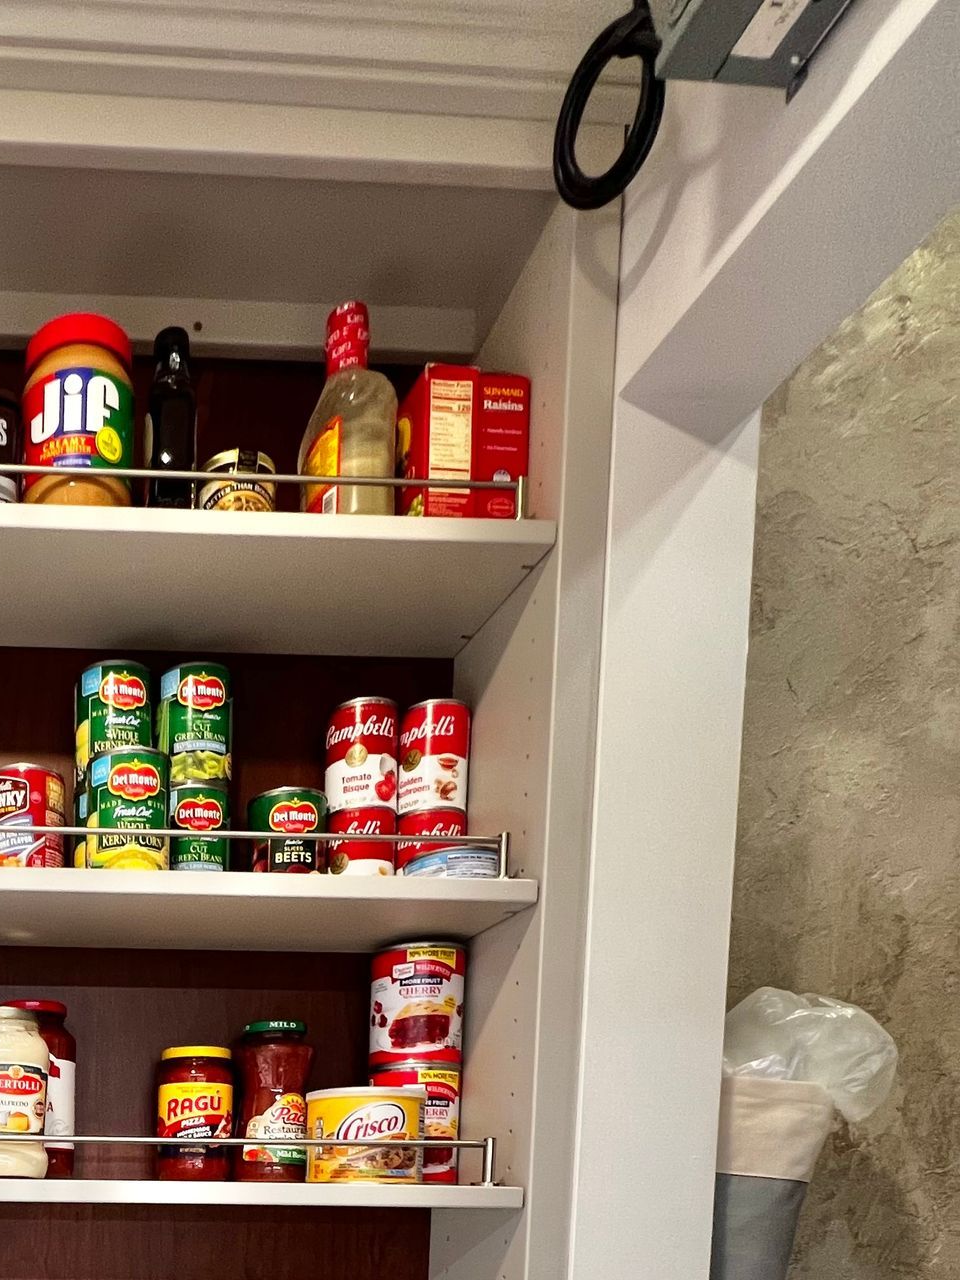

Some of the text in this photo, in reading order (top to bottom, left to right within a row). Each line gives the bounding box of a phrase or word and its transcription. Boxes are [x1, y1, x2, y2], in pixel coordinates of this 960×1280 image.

[31, 373, 120, 444] Jif
[483, 398, 524, 412] Raisins
[120, 684, 144, 699] Monte
[197, 685, 223, 698] Monte
[326, 715, 395, 749] Campbell's
[113, 773, 158, 787] Del Monte
[342, 773, 372, 784] Tomato
[343, 784, 369, 794] Bisque
[179, 807, 220, 820] Del Monte
[273, 810, 316, 823] Del Monte
[117, 822, 151, 830] WHOLE
[102, 834, 162, 848] KERNEL CORN
[190, 844, 208, 853] CUT
[200, 853, 223, 863] BEANS
[275, 852, 312, 864] BEETS
[399, 986, 441, 996] CHERRY
[269, 1021, 297, 1029] MILD
[273, 1106, 306, 1124] Pac
[425, 1108, 448, 1117] ERRY
[343, 1114, 400, 1141] Crisco
